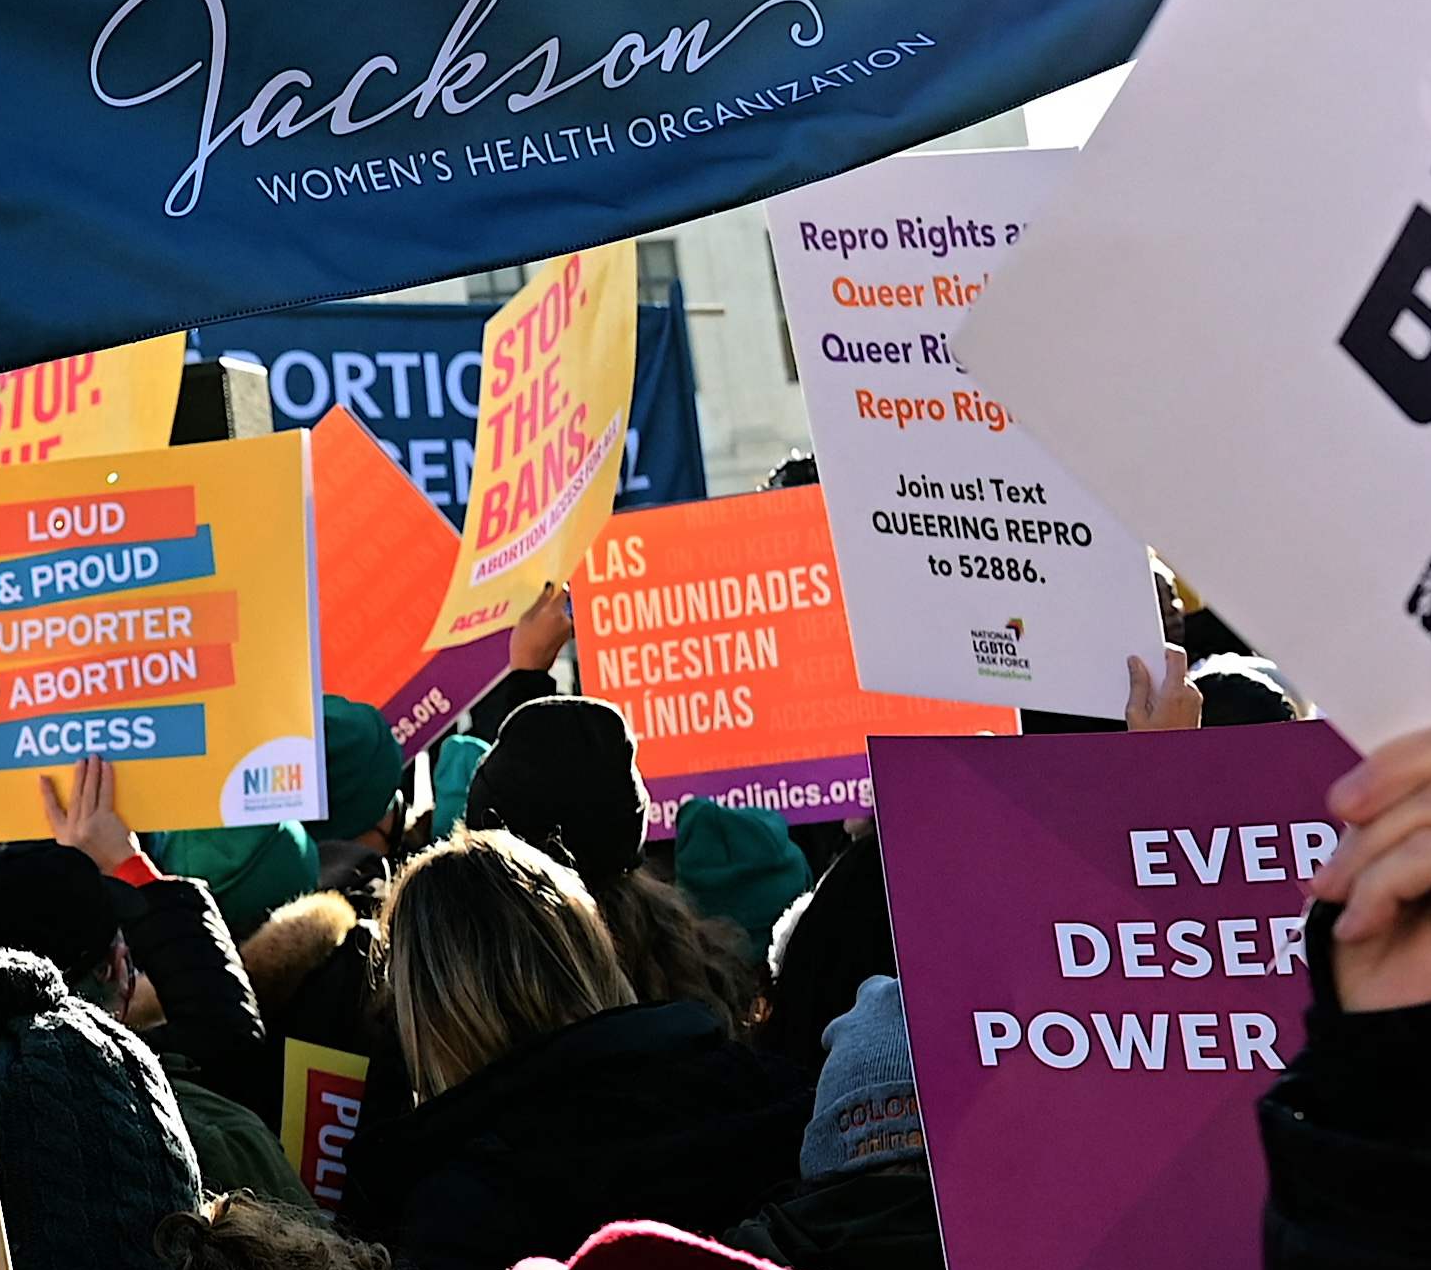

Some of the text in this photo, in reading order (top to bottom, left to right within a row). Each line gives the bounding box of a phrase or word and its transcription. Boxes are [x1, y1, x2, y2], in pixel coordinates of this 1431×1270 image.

[257, 30, 937, 206] WOMEN'S HEALTH ORGANIZATION
[799, 221, 888, 259] Repro
[895, 215, 996, 257] Rights
[832, 276, 924, 307] Queer
[490, 253, 587, 398] STOP.
[821, 333, 912, 363] Queer
[487, 355, 570, 473] THE.
[855, 389, 1014, 431] Repro Rig
[476, 403, 593, 551] BANS.
[896, 474, 1047, 504] Join us! Text
[27, 501, 125, 542] LOUD
[476, 520, 548, 580] ABORTION
[547, 470, 584, 533] ACCESS
[872, 511, 1092, 547] QUEERING REPRO
[32, 545, 159, 599] PROUD
[585, 536, 646, 584] LAS
[928, 555, 1046, 584] to 52886.
[450, 600, 509, 633] ACLU
[591, 563, 832, 638] COMUNIDADES
[597, 627, 779, 690] NECESITAN
[970, 630, 1014, 642] NATIONAL
[973, 640, 1017, 656] LGBTQ
[9, 648, 197, 711] ABORTION
[976, 655, 1030, 669] TASK FORCE
[621, 686, 754, 742] LÍNICAS
[13, 717, 157, 759] ACCESS
[243, 762, 303, 795] NIRH
[1053, 912, 1309, 978] DESER
[973, 1008, 1286, 1070] POWER
[314, 1091, 361, 1220] POLI
